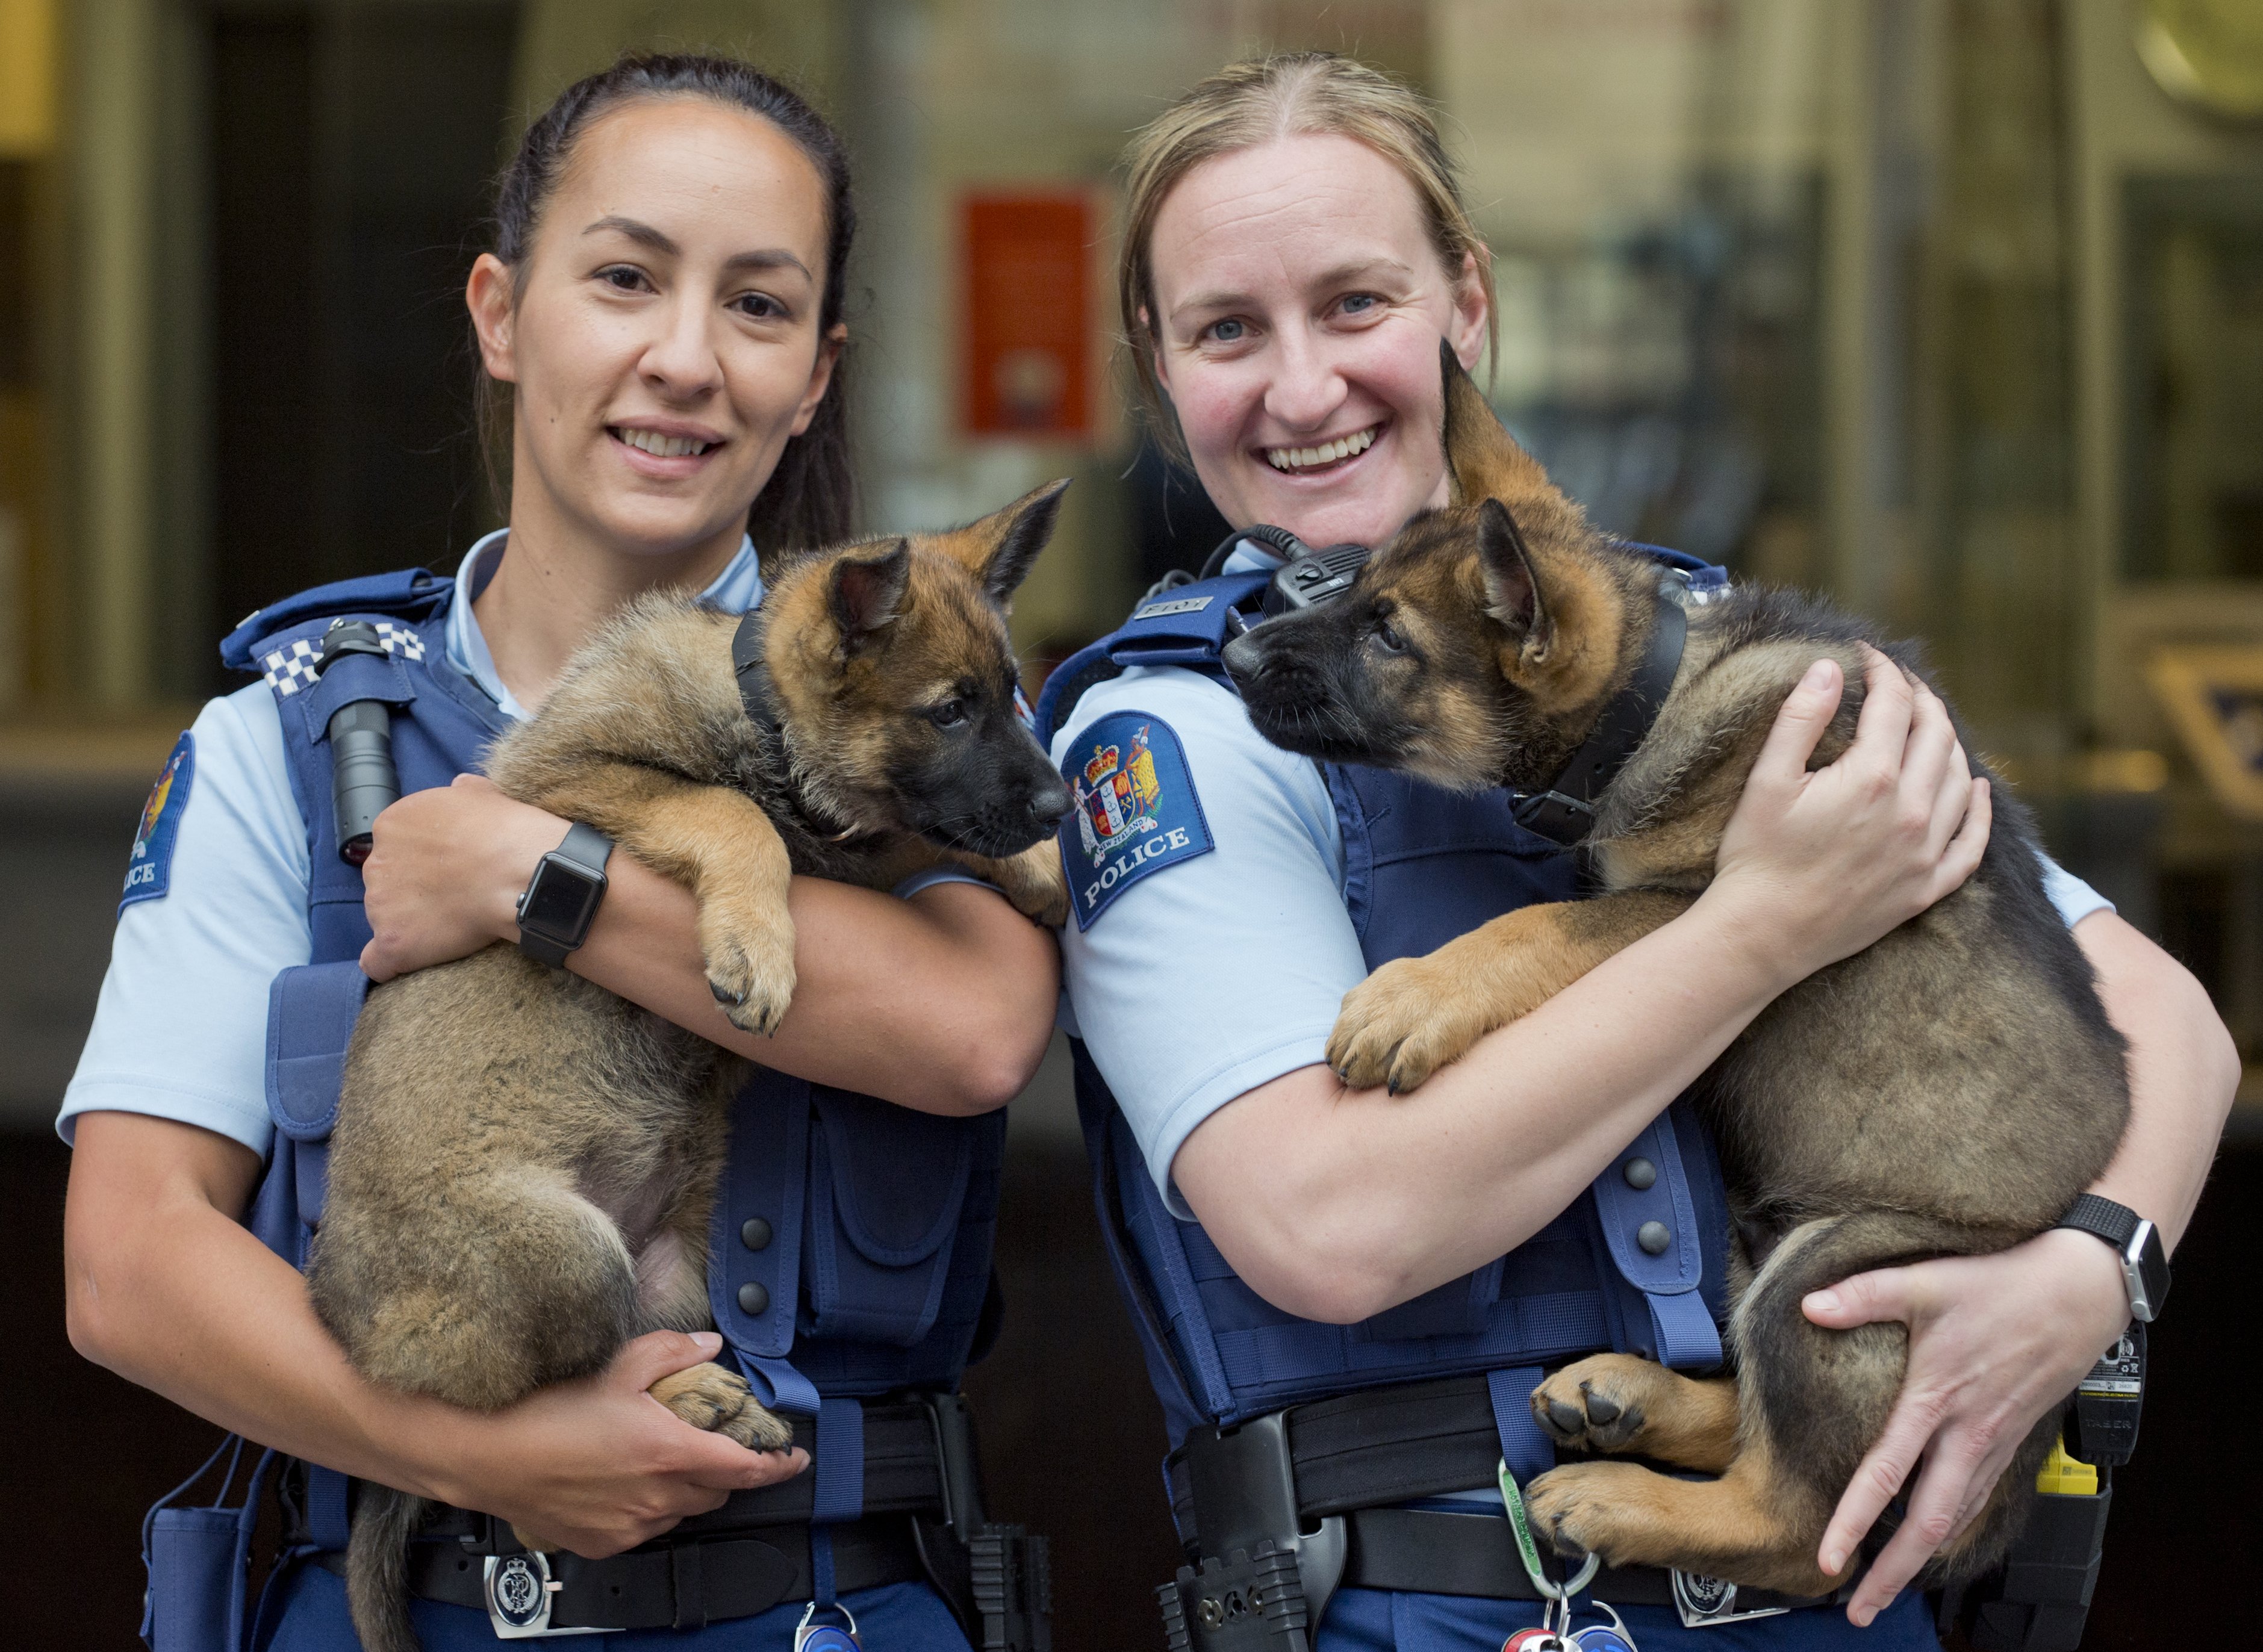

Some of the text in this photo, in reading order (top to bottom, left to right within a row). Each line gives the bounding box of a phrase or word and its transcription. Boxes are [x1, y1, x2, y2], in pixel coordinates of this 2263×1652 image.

[1098, 819, 1144, 852] NEW ZEALAND
[1085, 827, 1191, 909] POLICE
[2085, 1418, 2132, 1429] TASER
